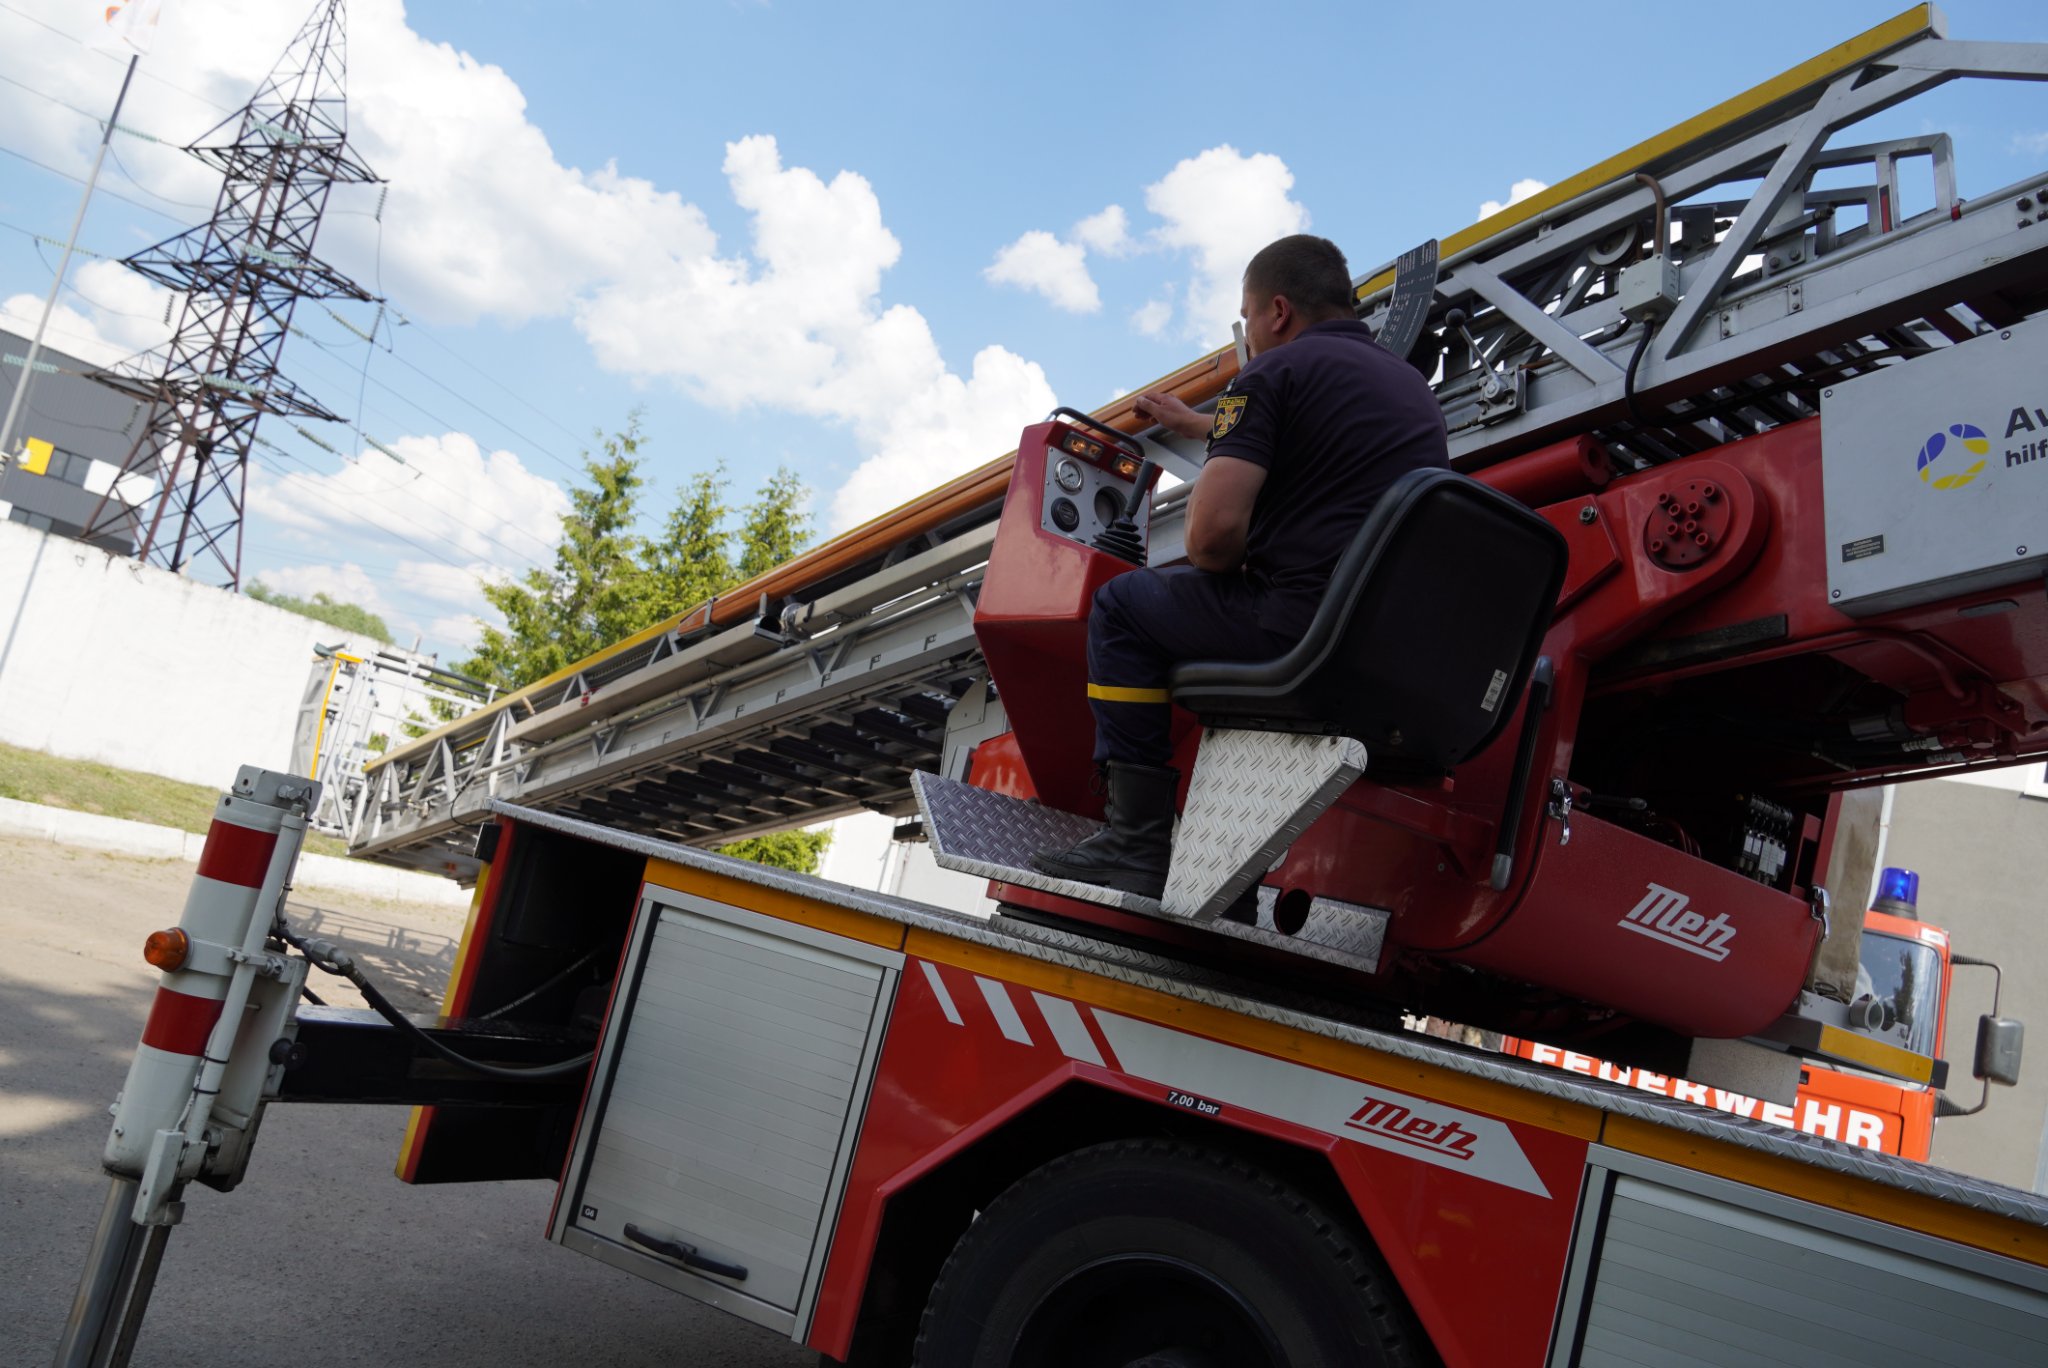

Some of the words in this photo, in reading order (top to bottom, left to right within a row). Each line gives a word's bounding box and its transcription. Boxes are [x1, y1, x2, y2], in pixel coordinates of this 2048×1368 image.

[1617, 882, 1737, 962] Metz
[1169, 1091, 1195, 1107] 7,00
[1197, 1100, 1220, 1115] bar
[1344, 1096, 1478, 1160] Metz
